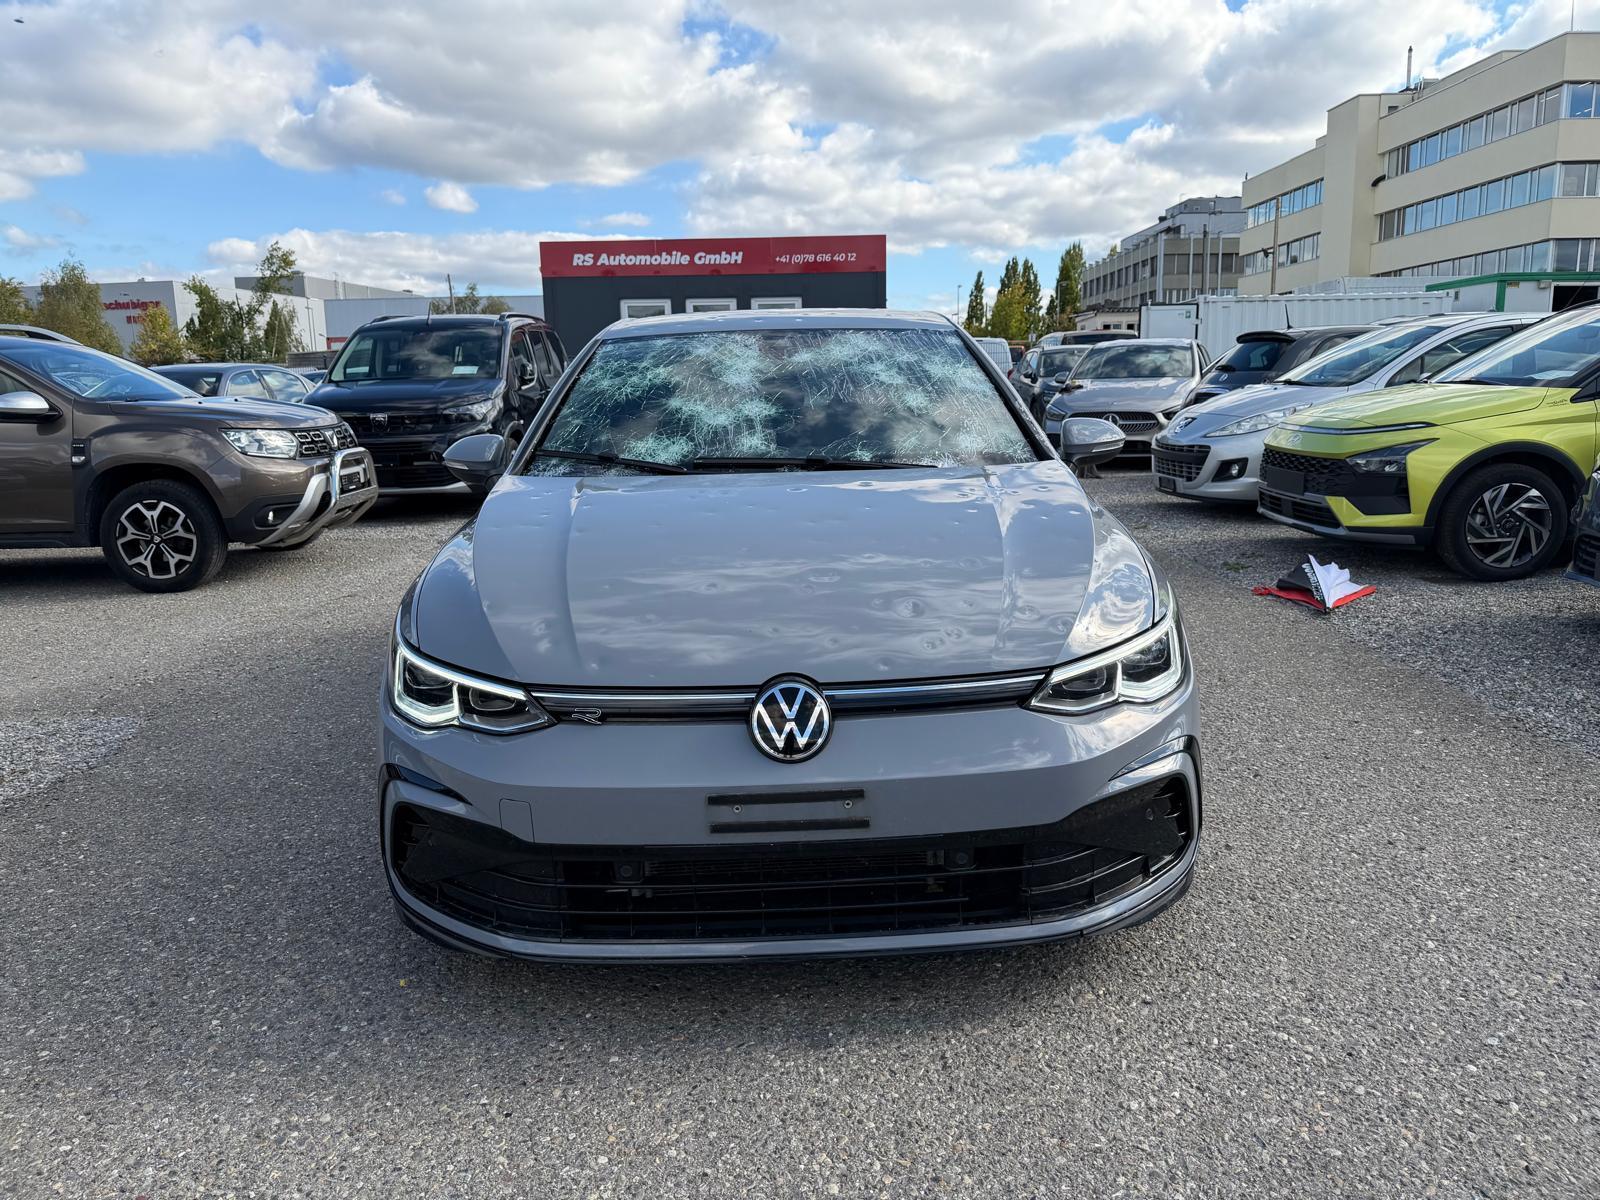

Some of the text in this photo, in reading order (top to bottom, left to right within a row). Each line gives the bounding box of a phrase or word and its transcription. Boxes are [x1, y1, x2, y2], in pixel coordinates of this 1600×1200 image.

[572, 251, 743, 266] RS Automobile GmbH
[775, 252, 857, 264] +41 (0)78 616 40 12
